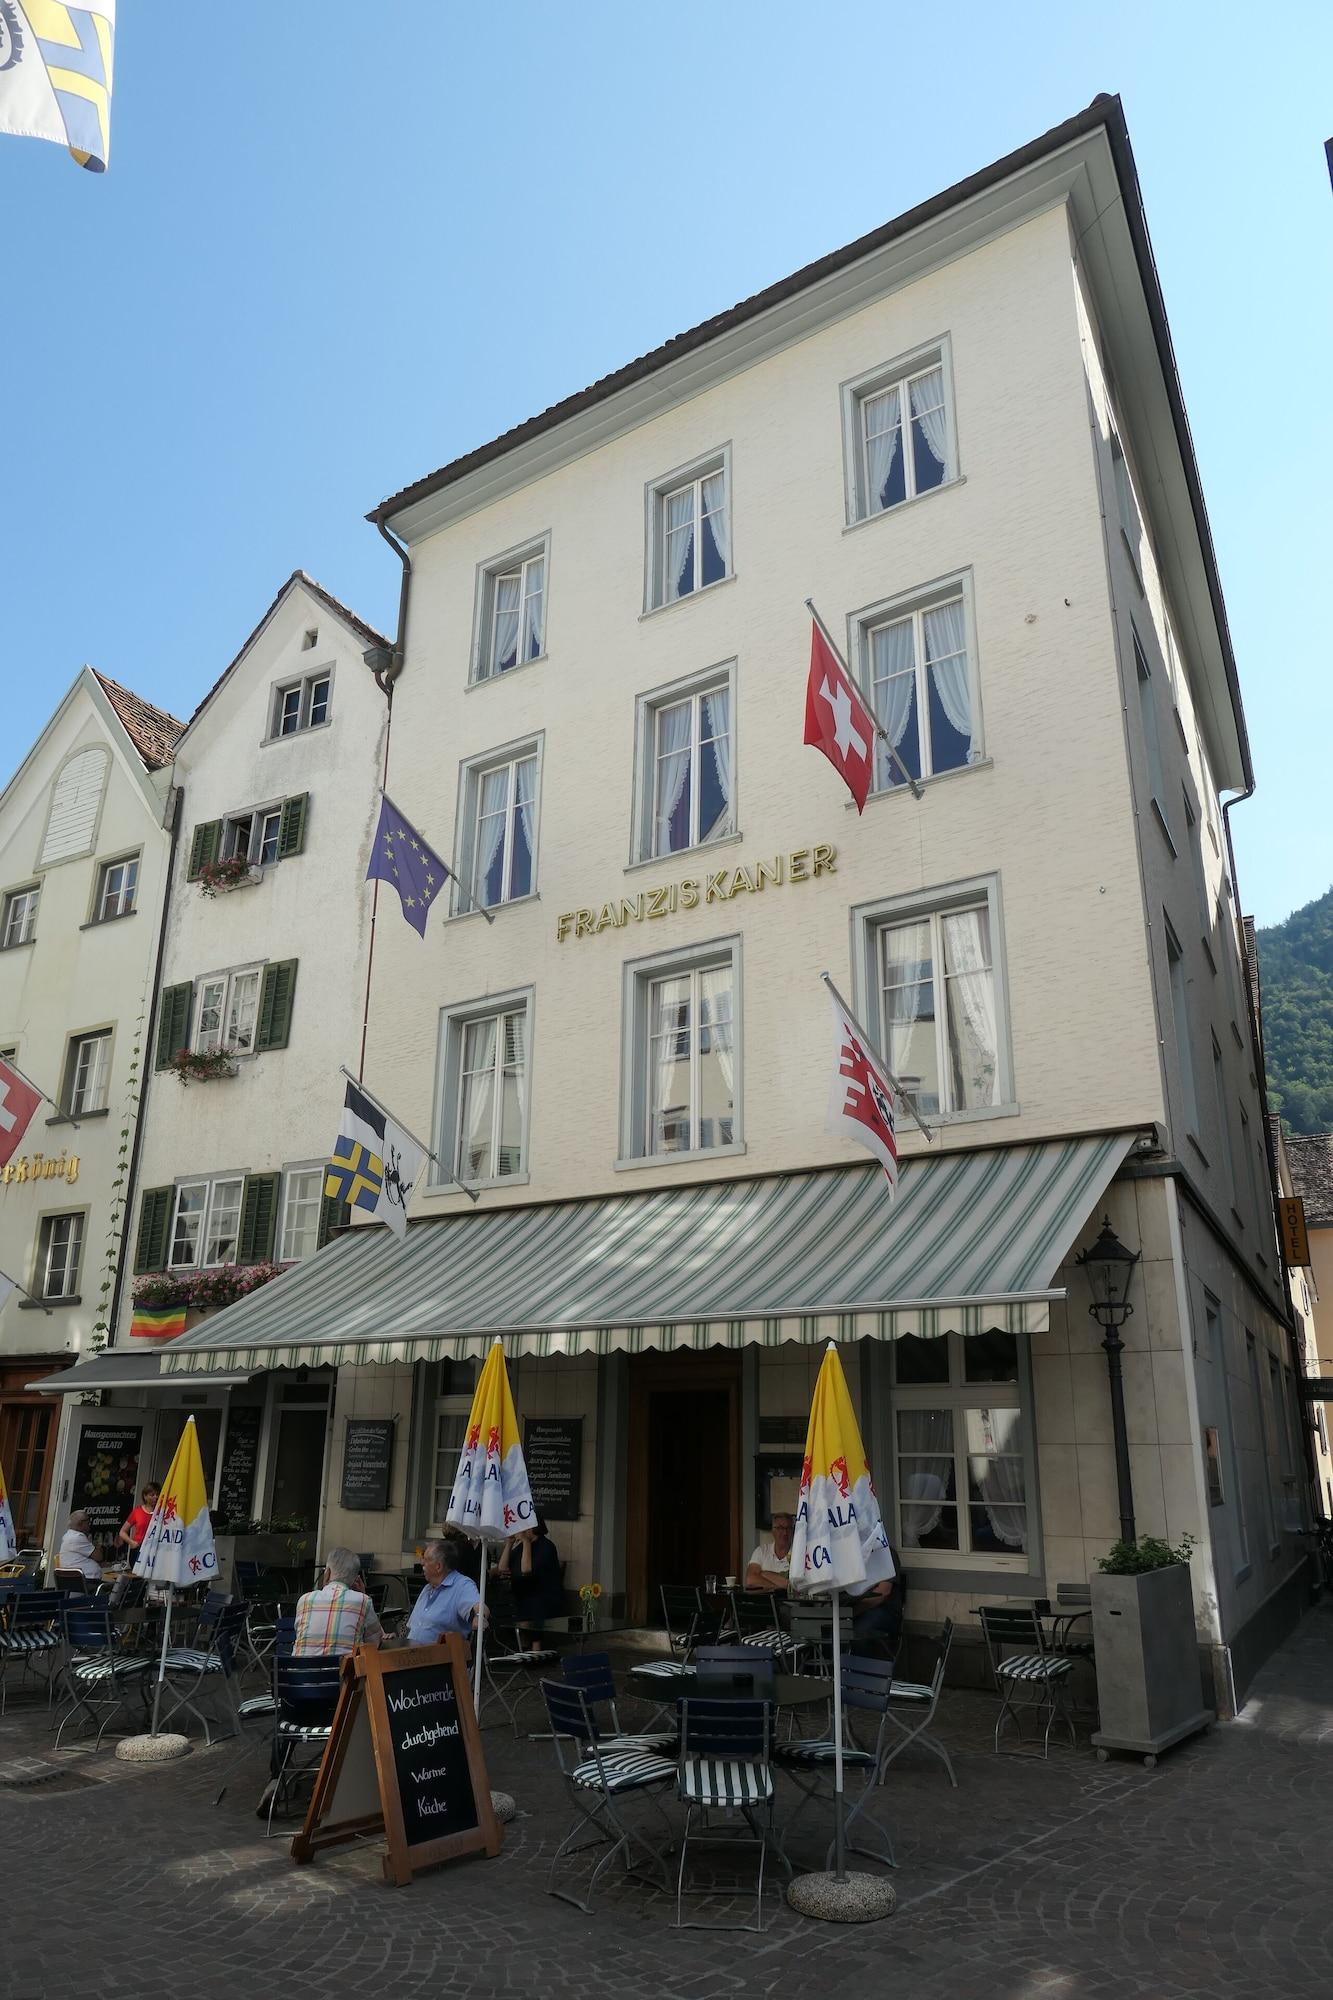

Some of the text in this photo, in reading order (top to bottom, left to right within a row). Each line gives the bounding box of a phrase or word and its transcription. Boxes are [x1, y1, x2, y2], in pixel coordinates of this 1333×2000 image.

[557, 841, 837, 943] FRANZISKANER
[1286, 1203, 1302, 1259] HOTEL
[84, 1430, 137, 1440] Hausgemachtes
[96, 1441, 124, 1449] GELATO
[388, 1682, 456, 1713] Wochenende
[401, 1720, 459, 1750] durchgehend
[417, 1797, 448, 1818] Küche
